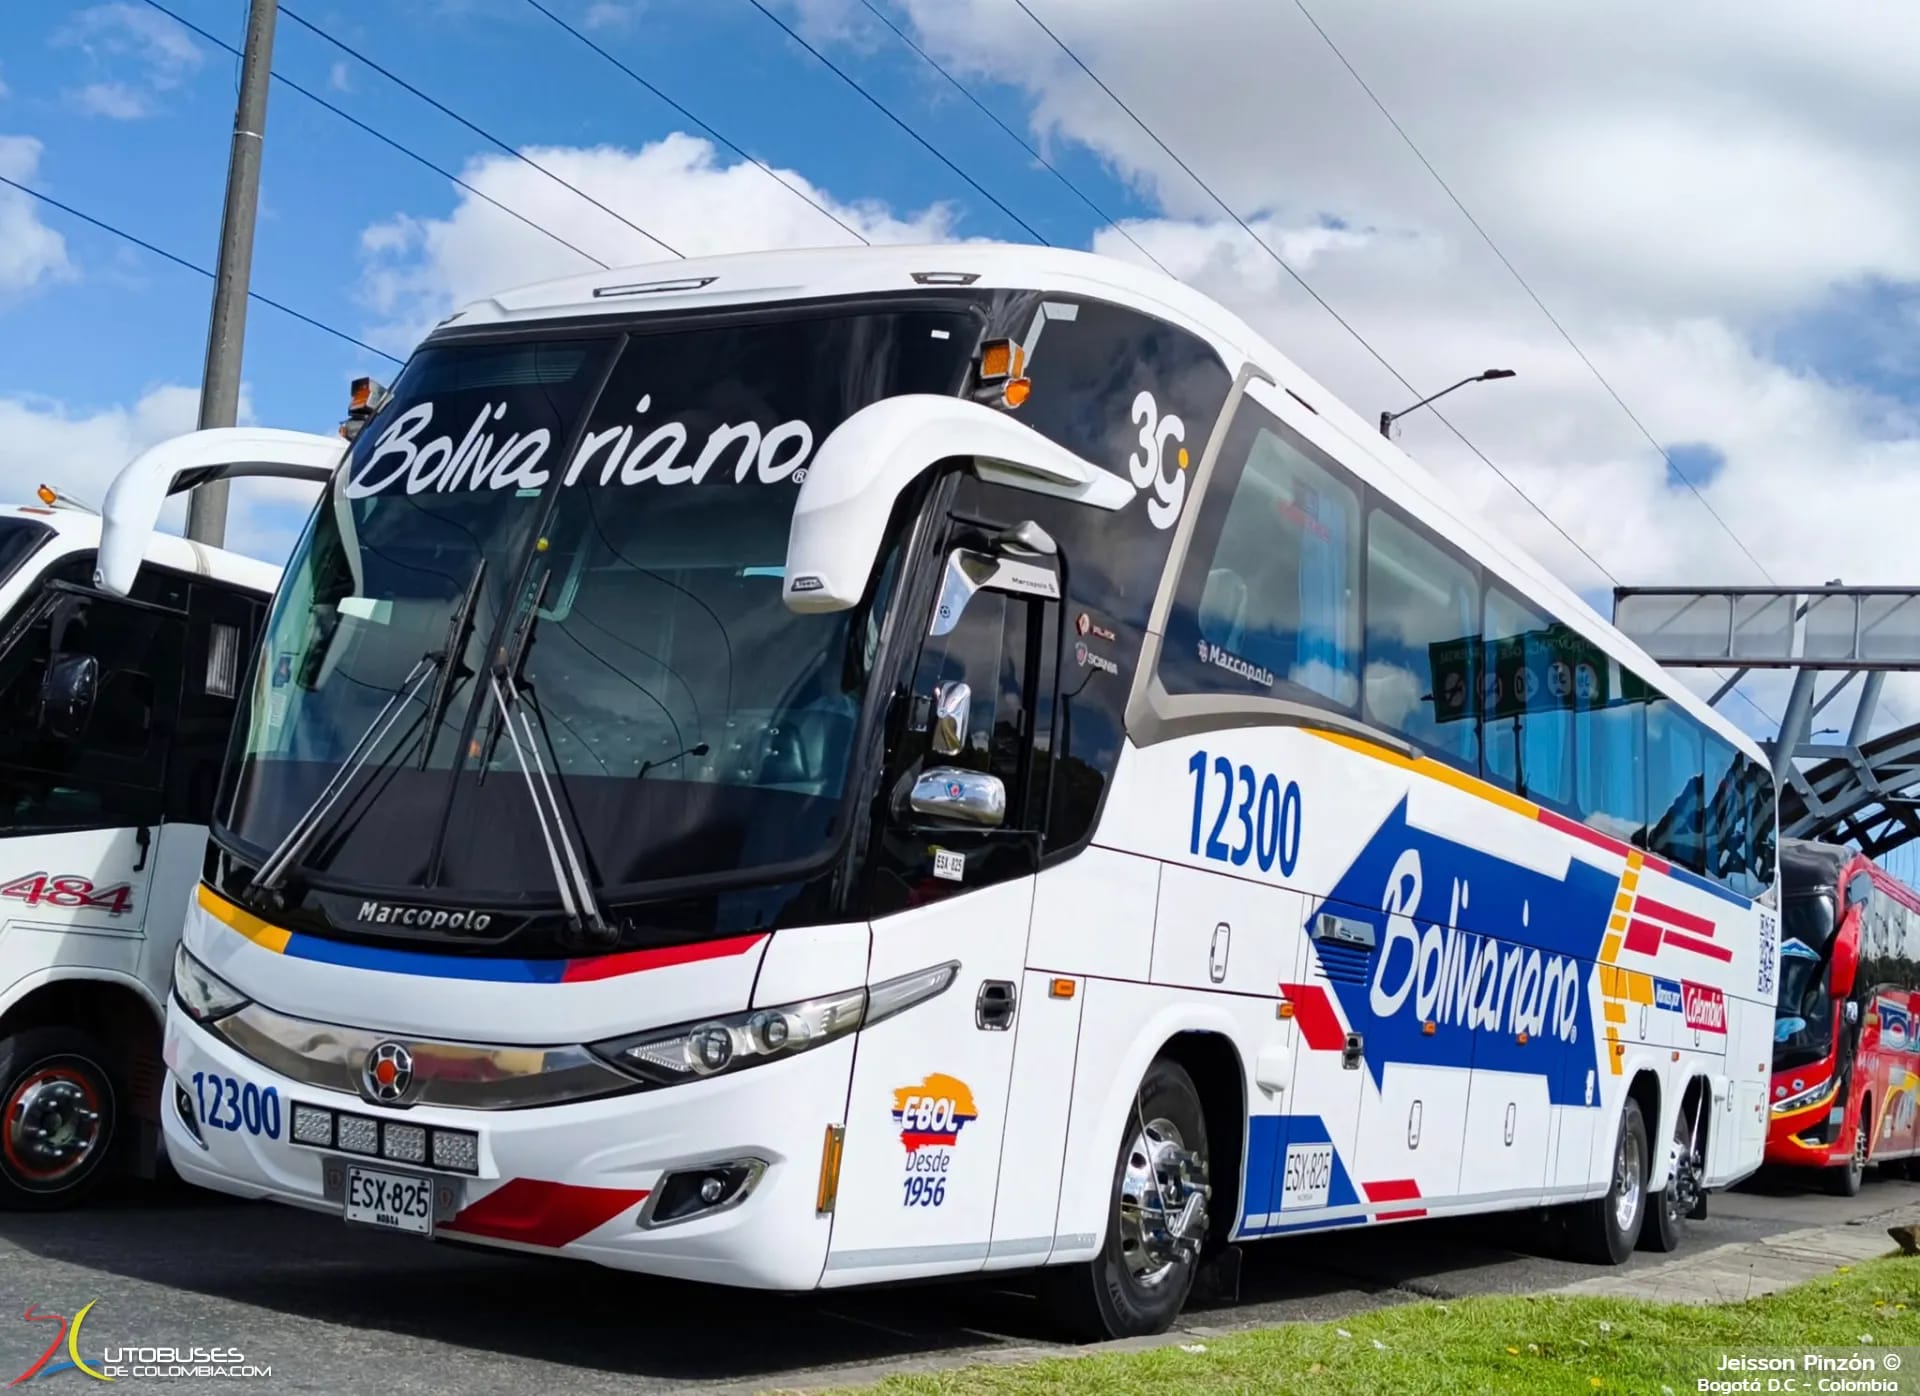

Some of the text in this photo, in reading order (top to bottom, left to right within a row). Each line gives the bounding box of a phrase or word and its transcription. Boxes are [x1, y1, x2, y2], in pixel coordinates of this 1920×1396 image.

[1209, 645, 1273, 687] Marcopolo
[1189, 750, 1301, 878] 12300
[0, 871, 132, 917] 484
[357, 902, 491, 931] Marcopolo
[1370, 848, 1579, 1042] Bolivariano
[193, 1071, 280, 1140] 12300
[905, 1149, 950, 1172] Desde
[903, 1176, 946, 1206] 1956
